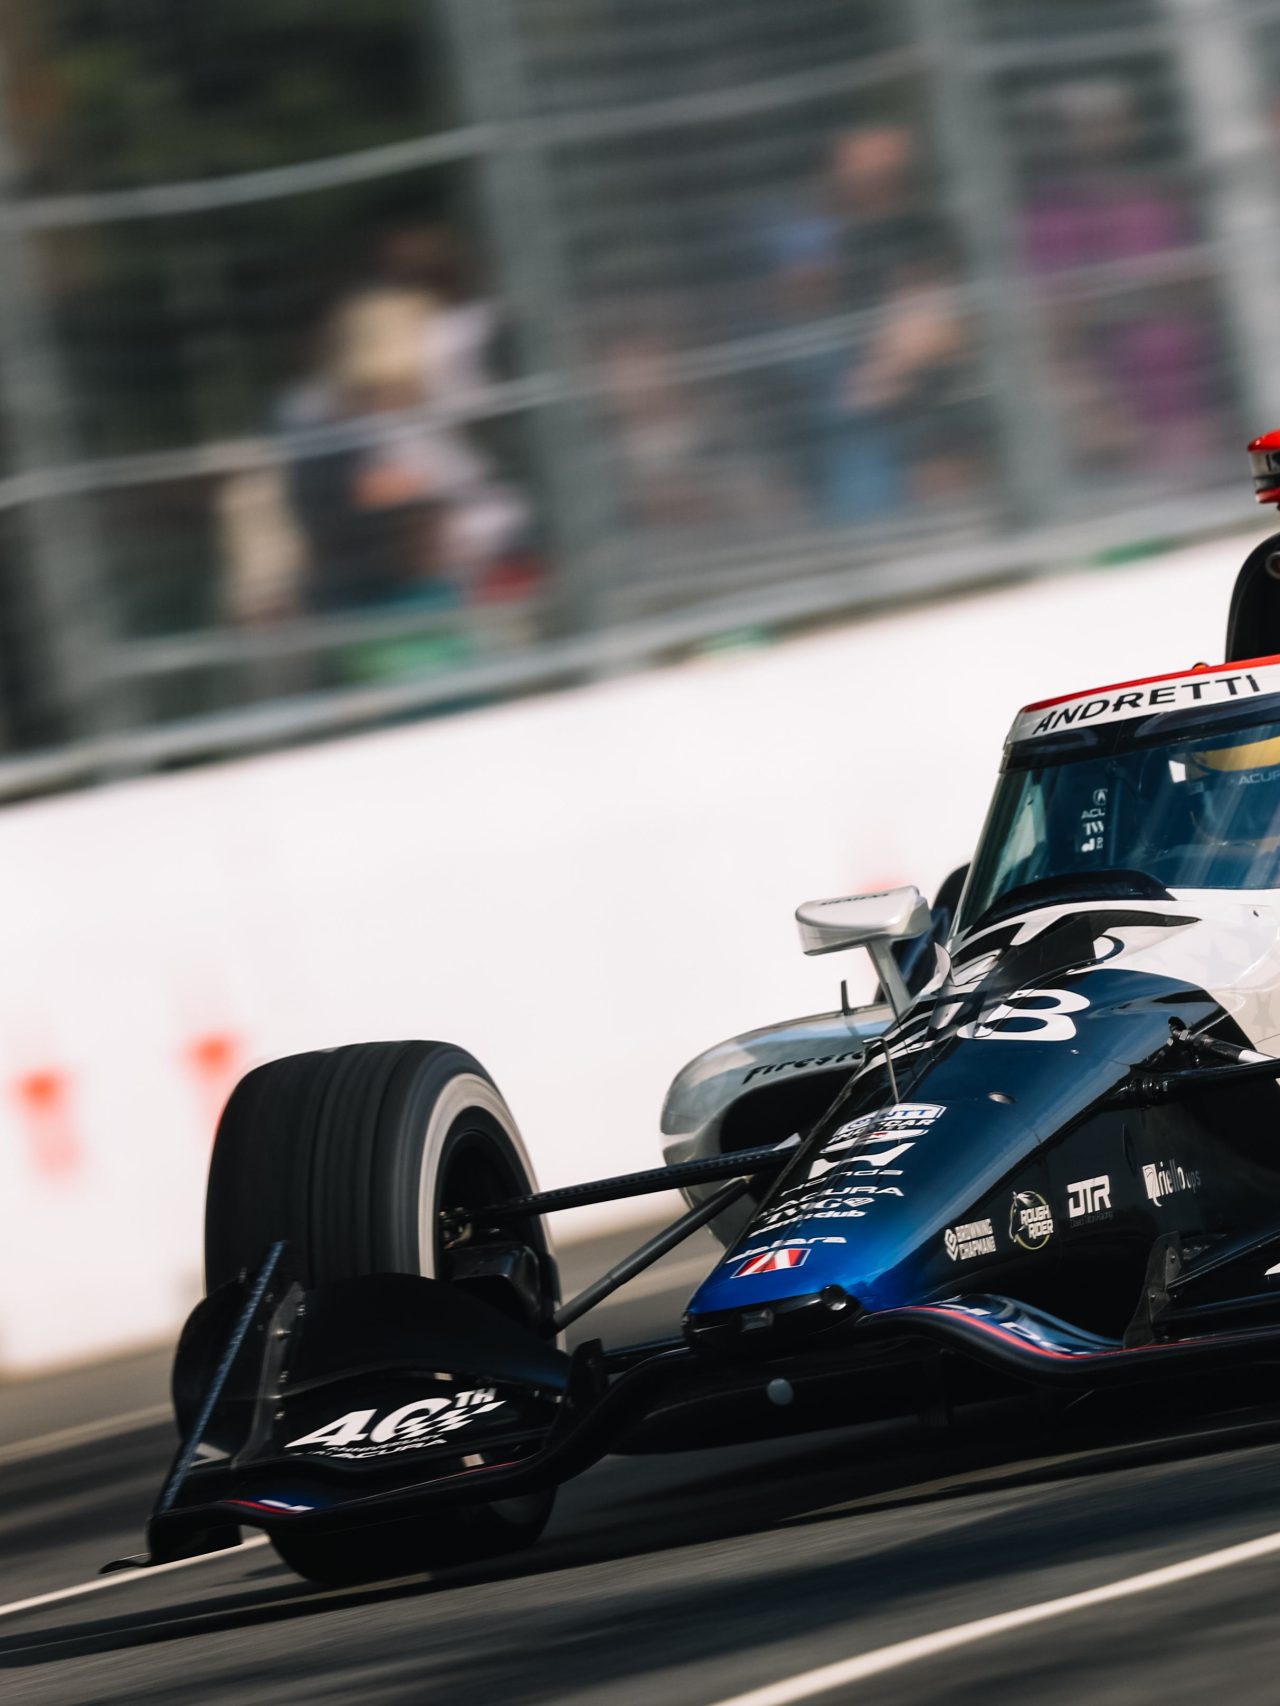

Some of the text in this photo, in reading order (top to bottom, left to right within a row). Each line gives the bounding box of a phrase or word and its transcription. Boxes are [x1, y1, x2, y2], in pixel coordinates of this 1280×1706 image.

[1032, 674, 1261, 735] ANDRETTI
[770, 1186, 905, 1214] ACURA
[1020, 1204, 1051, 1226] ROUGH
[1028, 1219, 1054, 1240] RIDER
